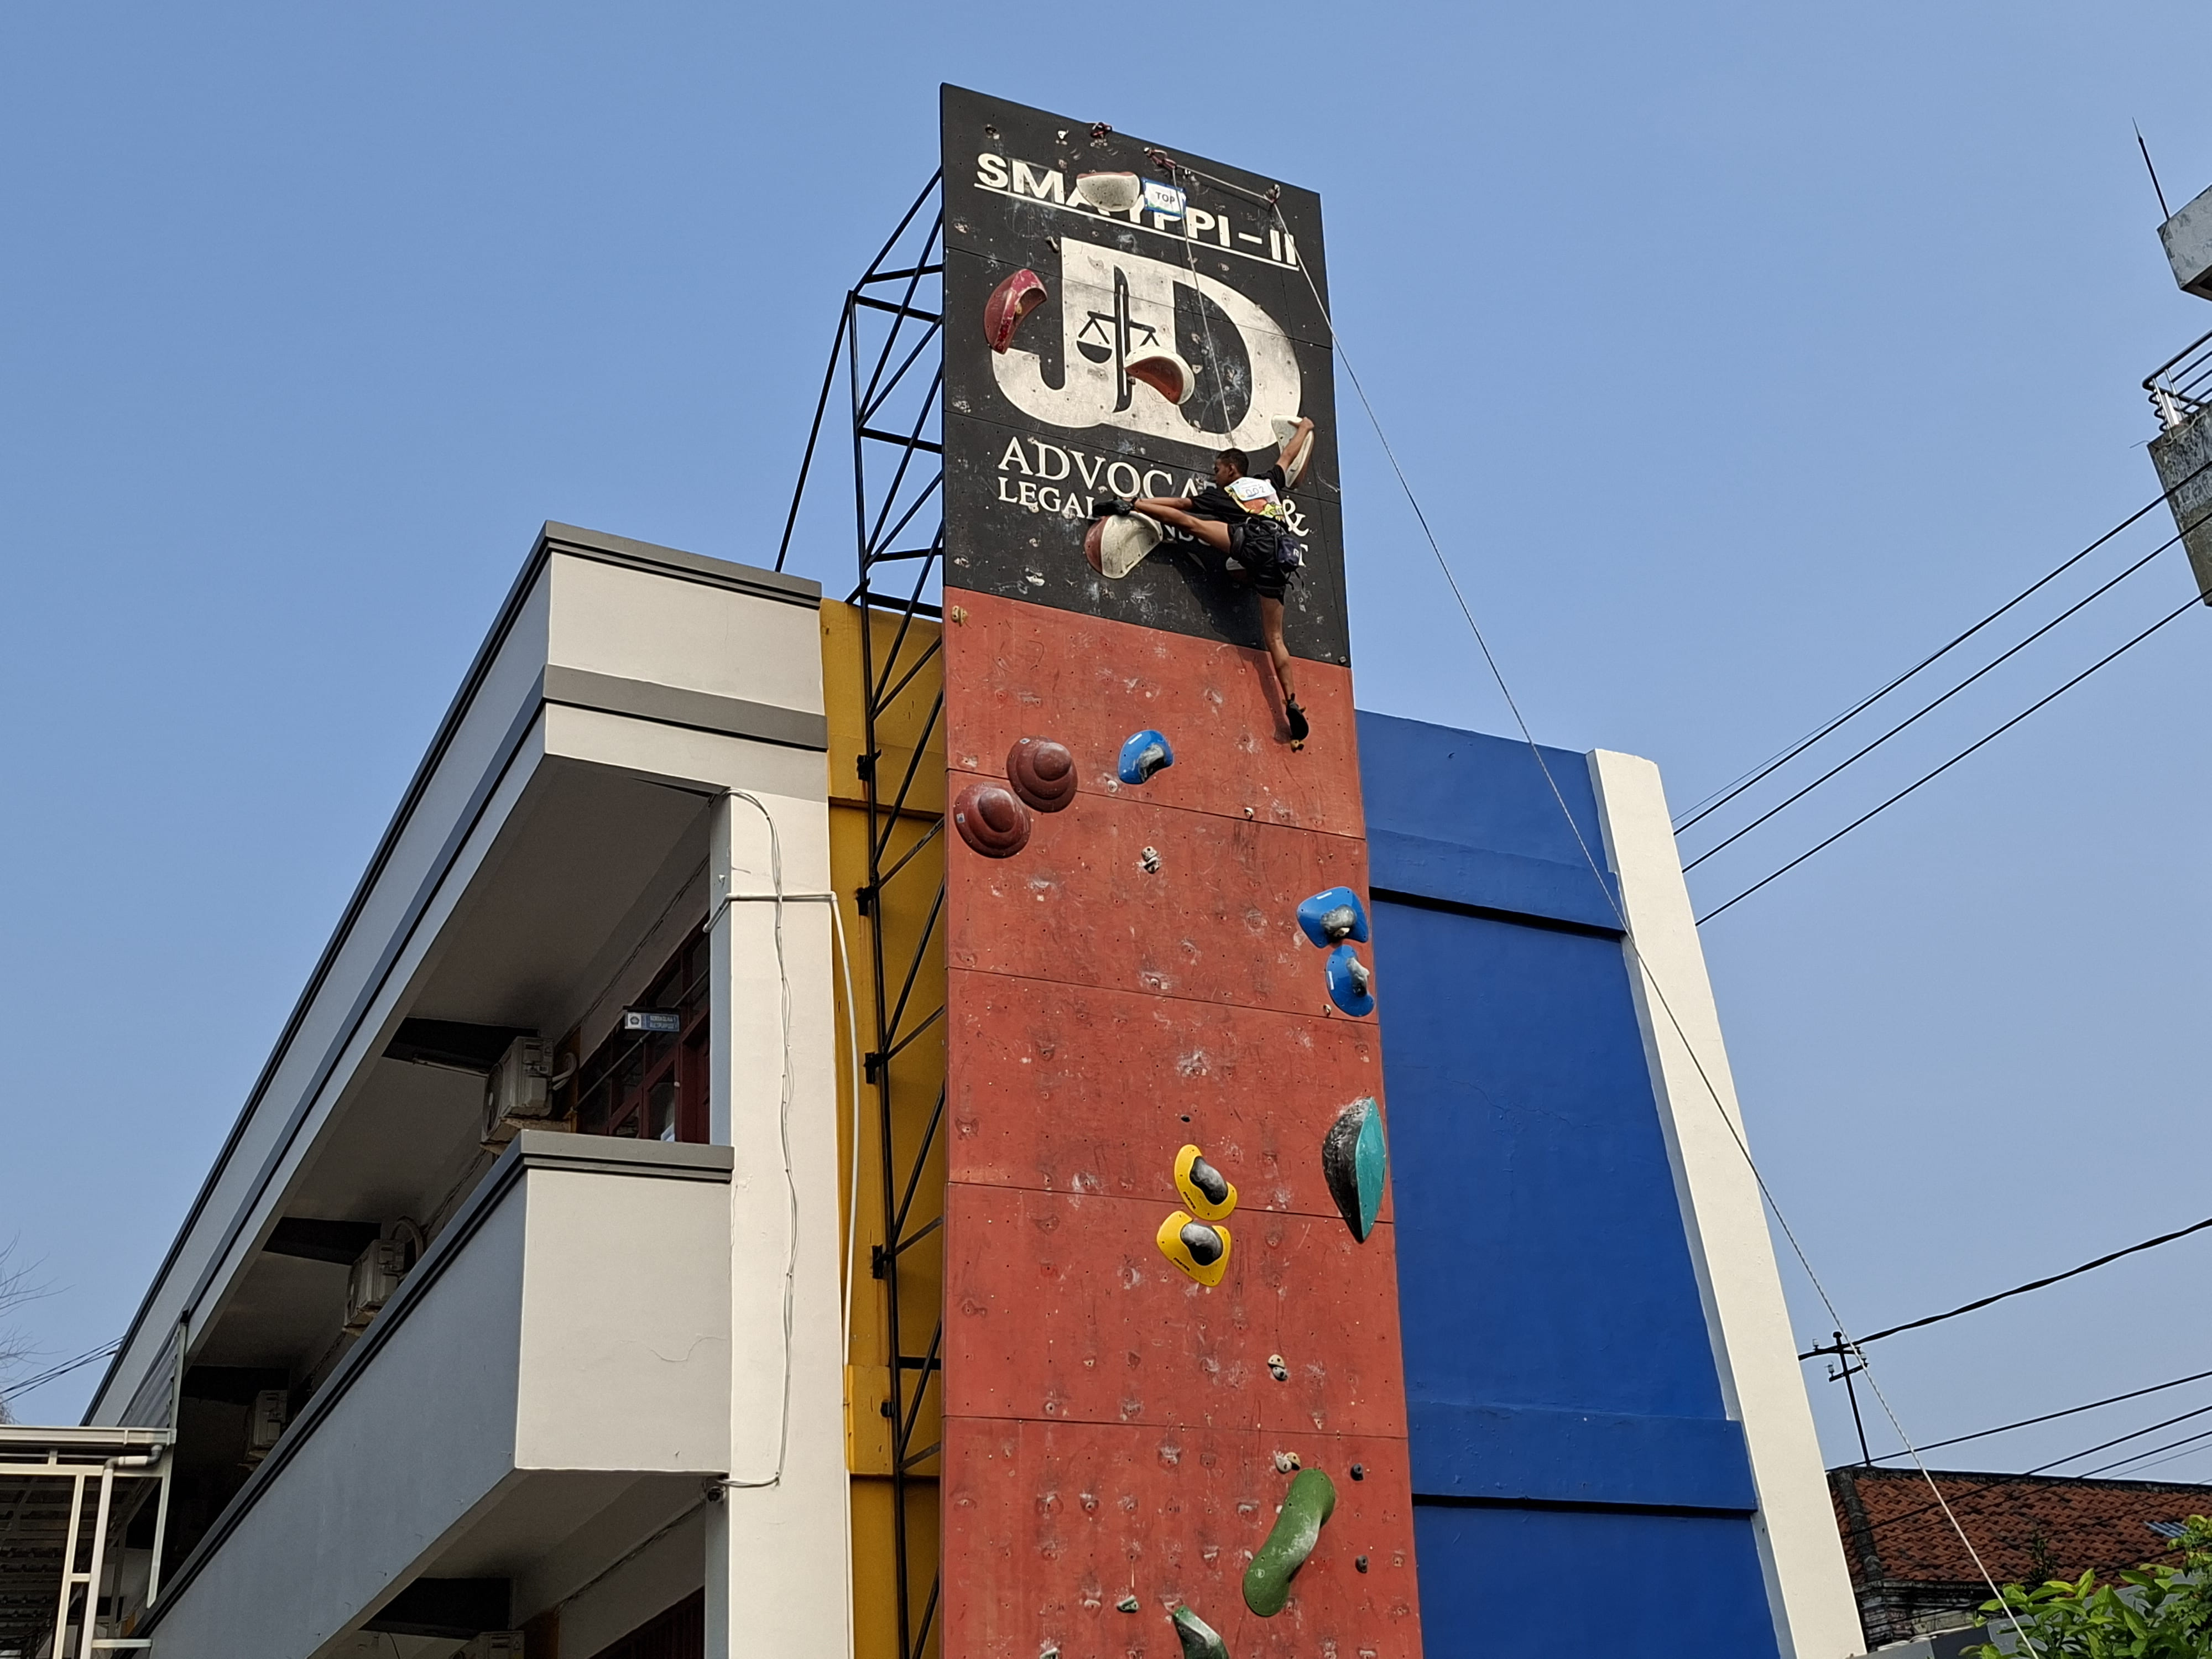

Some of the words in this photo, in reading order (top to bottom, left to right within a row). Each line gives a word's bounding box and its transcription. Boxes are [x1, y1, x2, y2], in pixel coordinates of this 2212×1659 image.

[1155, 191, 1175, 204] TOP
[992, 237, 1301, 452] JD
[998, 476, 1099, 520] LEGAL
[1282, 499, 1309, 536] &
